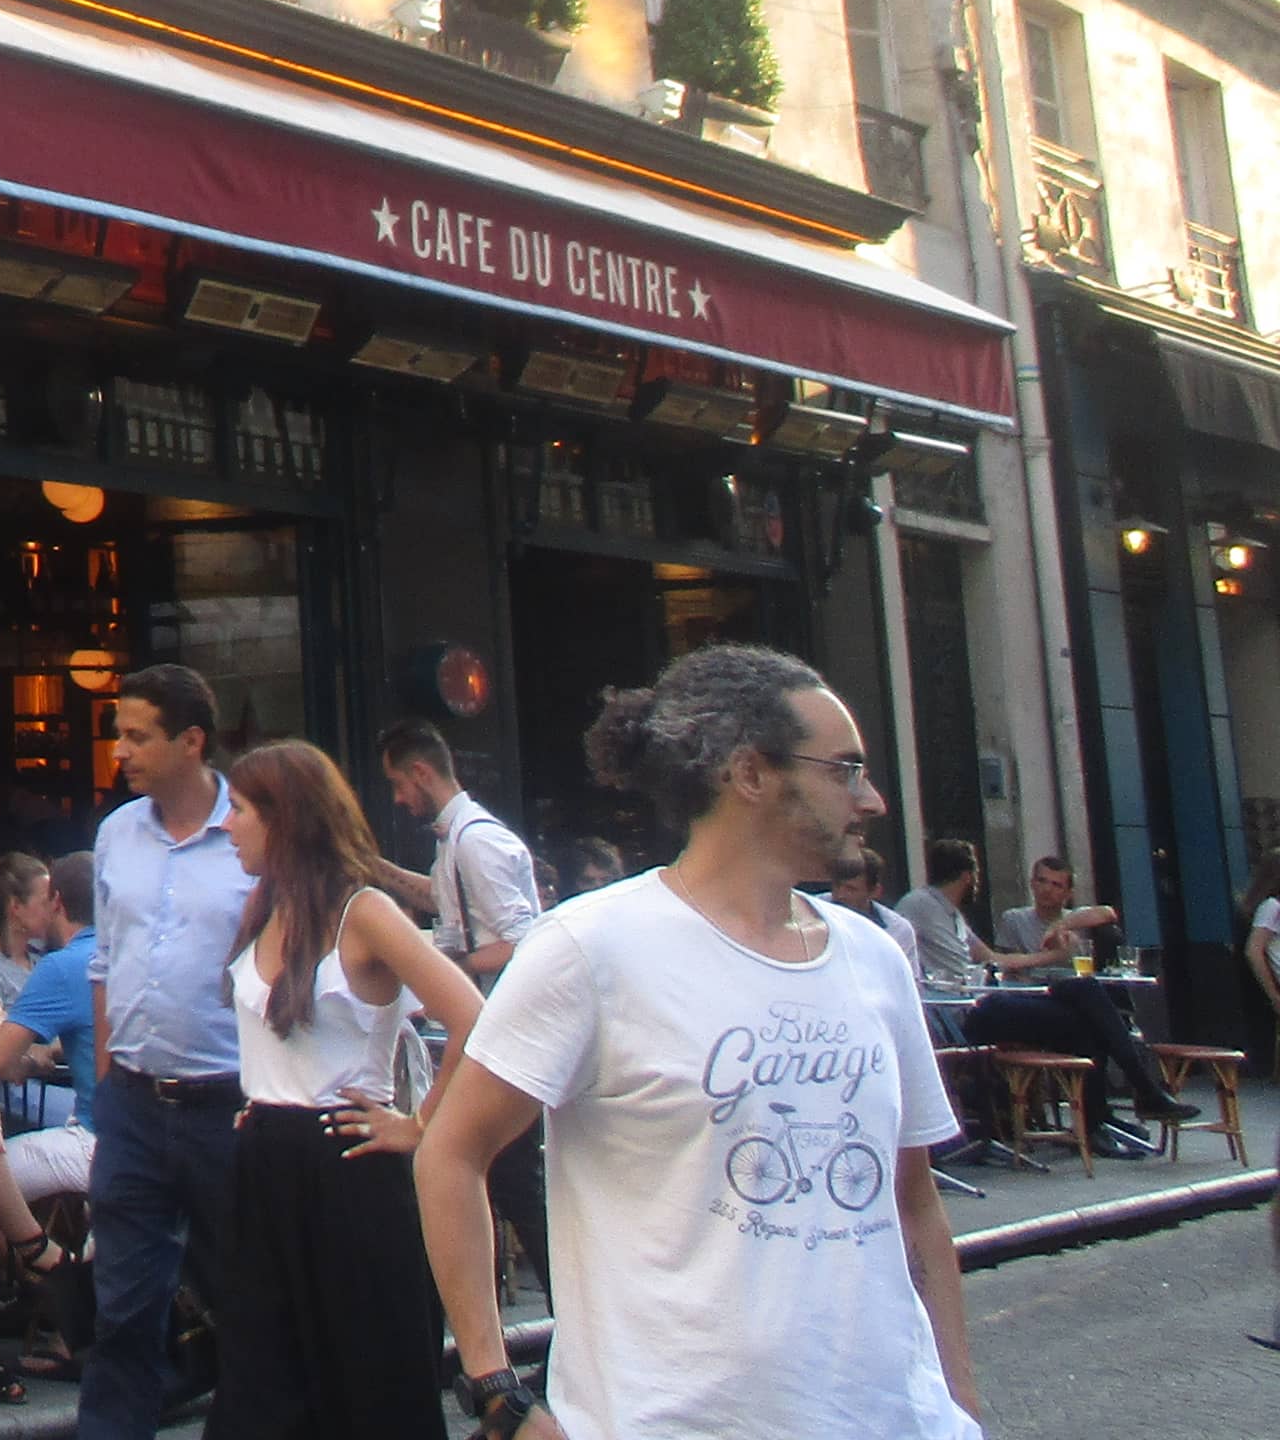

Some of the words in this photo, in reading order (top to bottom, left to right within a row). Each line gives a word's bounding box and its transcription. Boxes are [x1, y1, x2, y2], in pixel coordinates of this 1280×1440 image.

[410, 200, 495, 274] CAFE
[509, 226, 551, 287] DU
[567, 241, 681, 318] CENTRE
[759, 1001, 850, 1046] Bike
[701, 1026, 887, 1125] Garage
